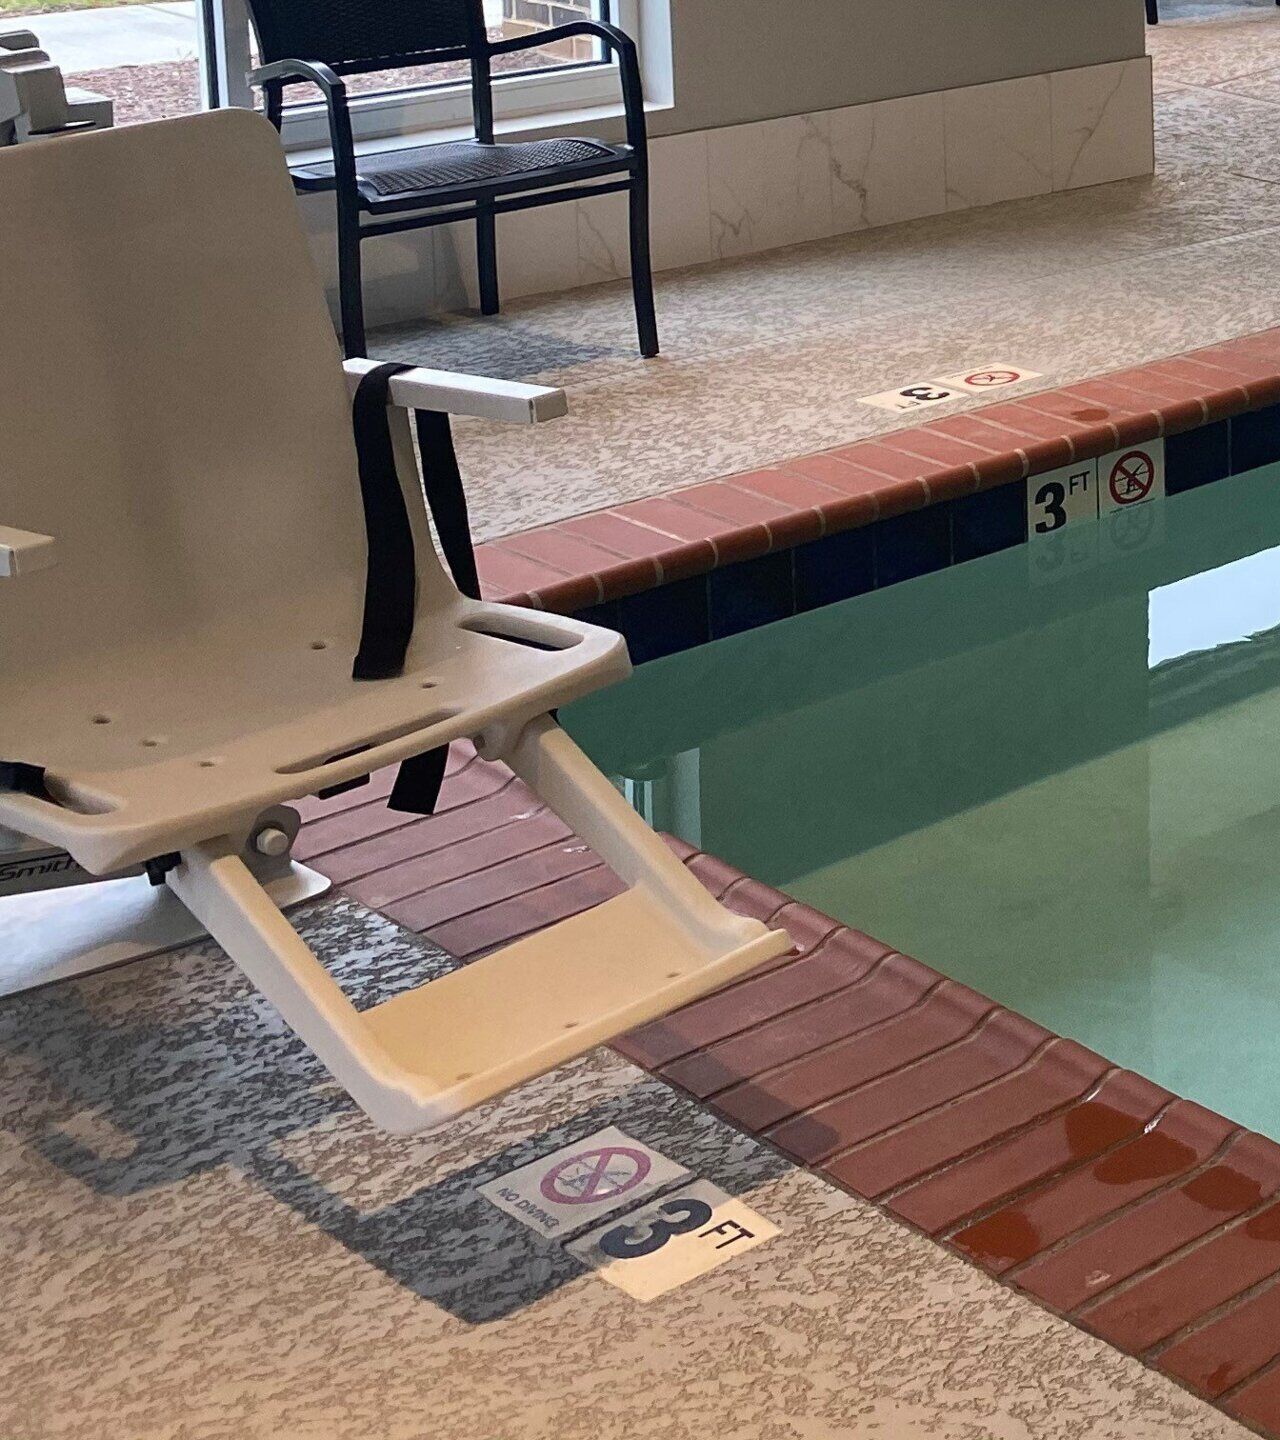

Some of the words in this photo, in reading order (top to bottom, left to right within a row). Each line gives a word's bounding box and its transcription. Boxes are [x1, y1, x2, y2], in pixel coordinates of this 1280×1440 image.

[900, 387, 950, 401] 3
[1035, 482, 1067, 534] 3
[1069, 471, 1090, 496] FT
[496, 1188, 519, 1201] NO
[514, 1200, 559, 1228] DIVING
[600, 1198, 712, 1259] 3
[698, 1220, 755, 1249] FT
